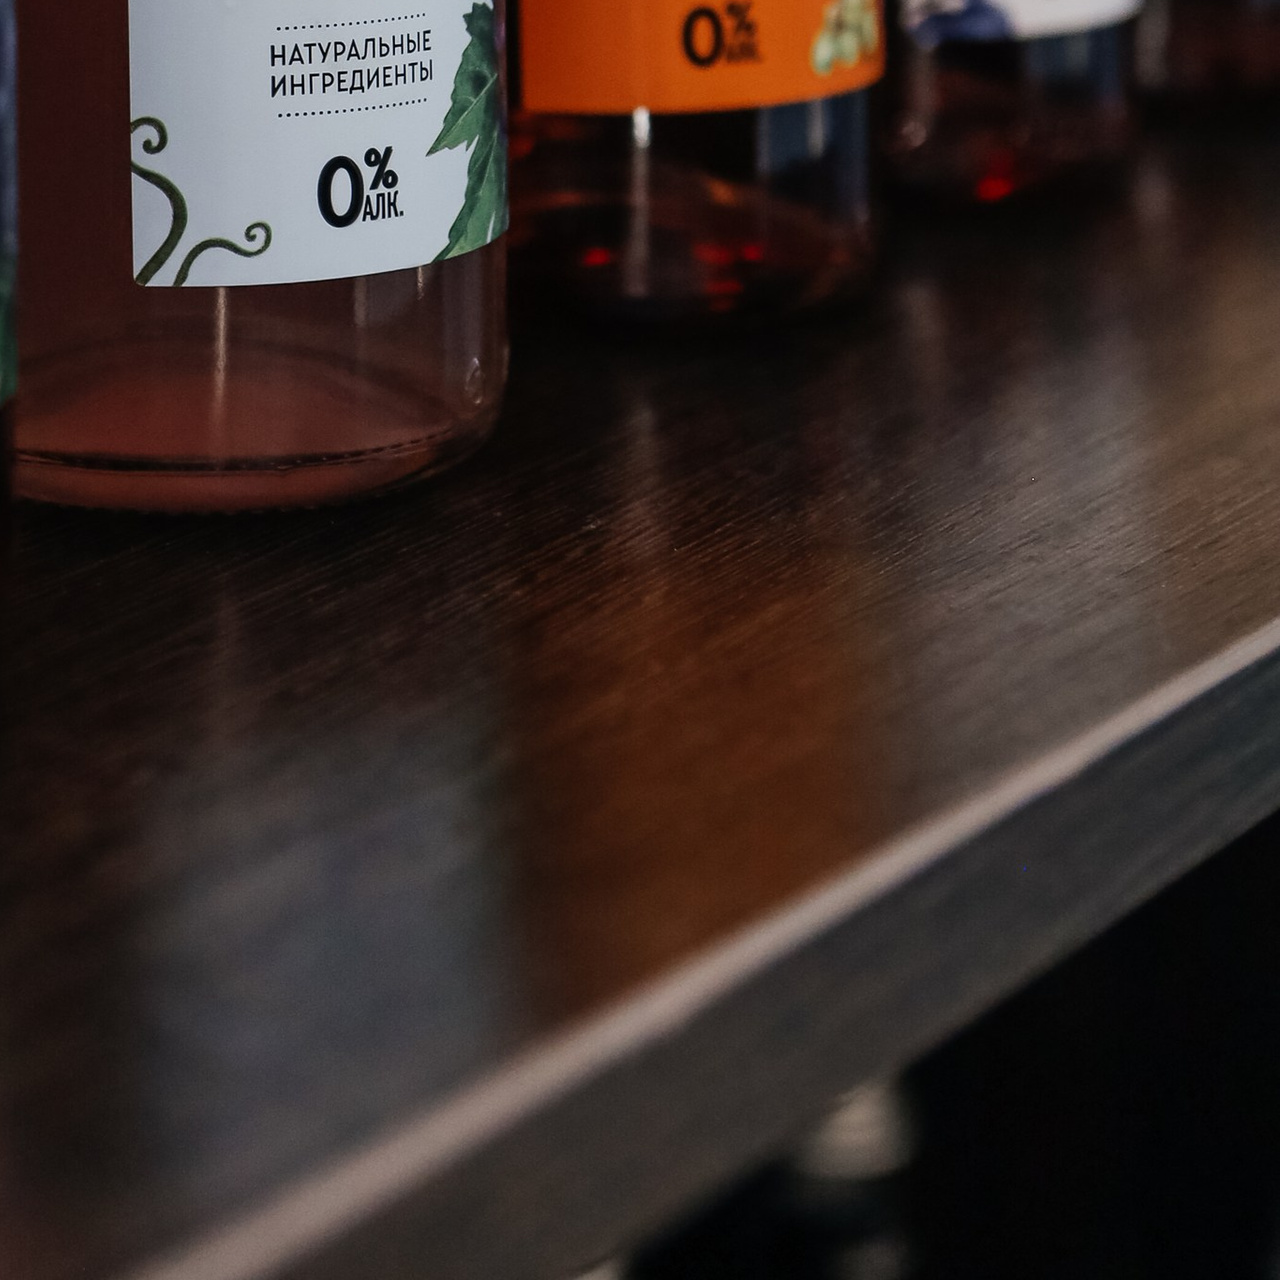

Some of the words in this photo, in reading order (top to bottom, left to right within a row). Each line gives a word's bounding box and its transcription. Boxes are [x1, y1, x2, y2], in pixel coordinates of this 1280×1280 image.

[270, 29, 432, 67] НАТУРАЛЬНЫЕ
[271, 59, 434, 99] ИНГРЕДИЕНТЫ
[317, 146, 399, 228] 0%
[362, 189, 404, 223] АЛК.
